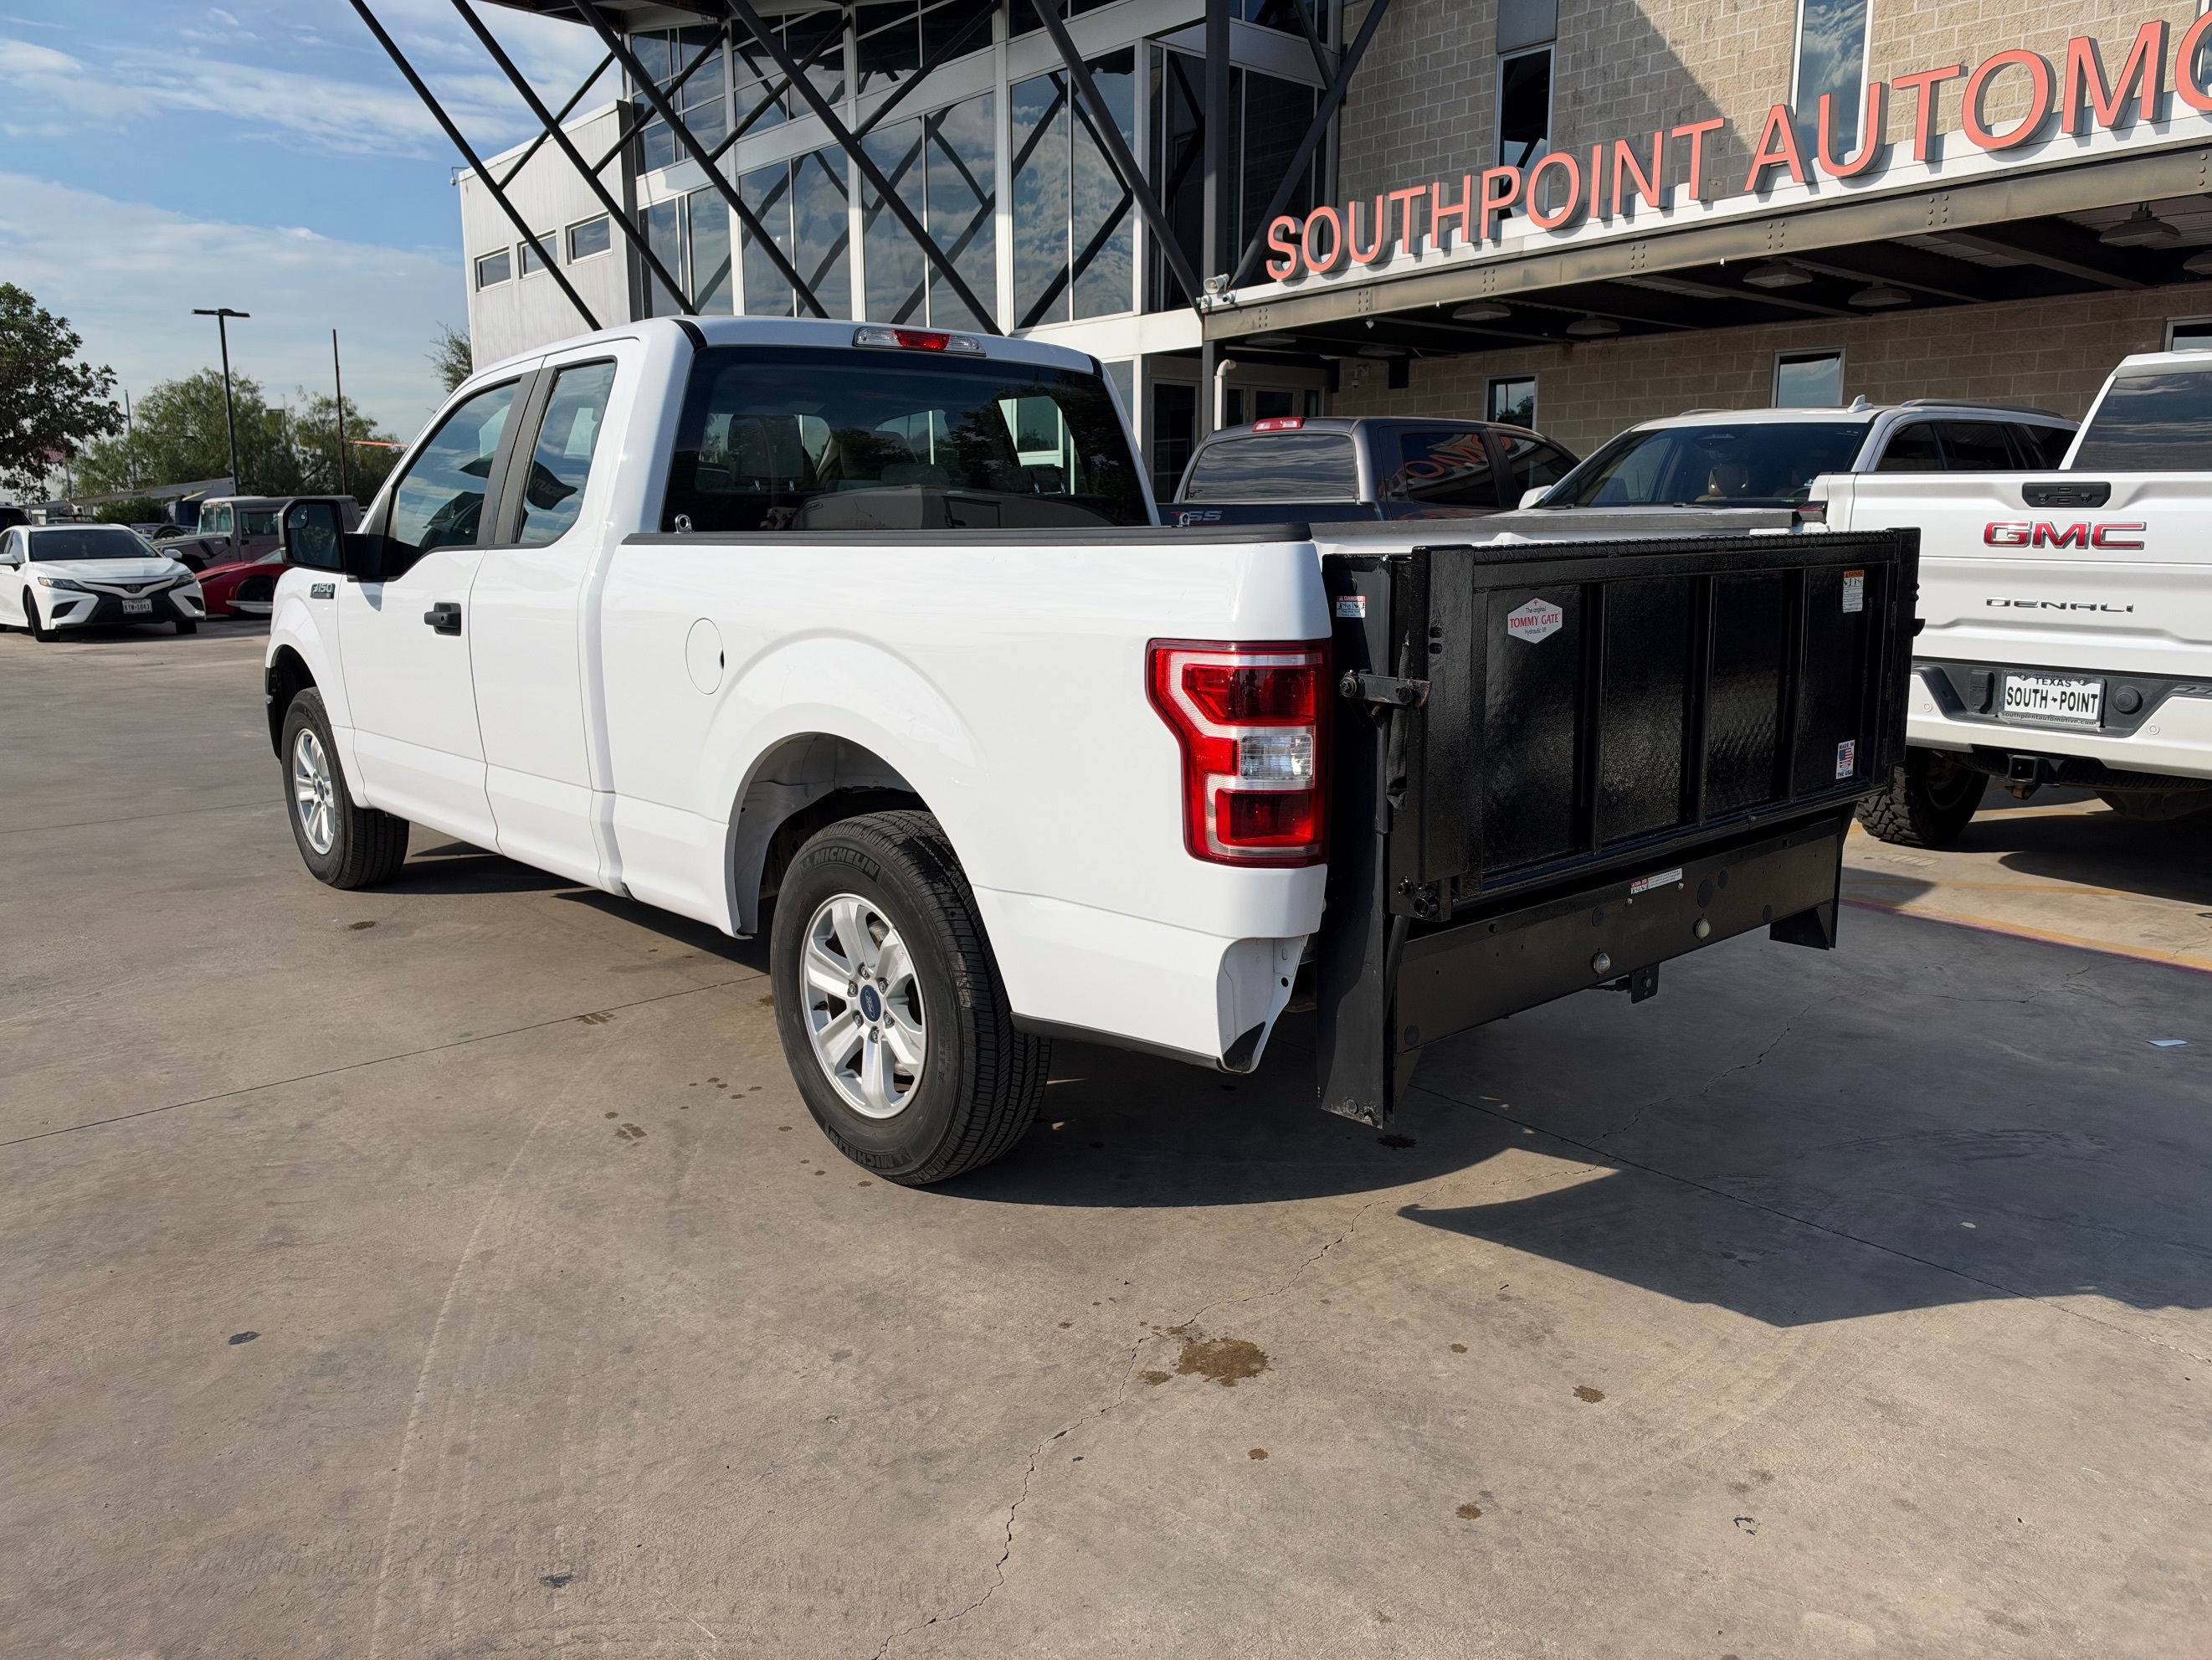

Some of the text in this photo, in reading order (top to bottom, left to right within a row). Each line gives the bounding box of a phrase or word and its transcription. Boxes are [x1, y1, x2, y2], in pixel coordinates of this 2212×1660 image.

[1265, 116, 1727, 280] SOUTHPOINT
[1984, 521, 2147, 550] GMC
[1986, 597, 2134, 613] DENALI
[1510, 613, 1559, 629] TOMMY GATE
[1524, 627, 1542, 636] hydraulic
[2035, 676, 2072, 688] TEXAS
[2006, 686, 2099, 714] SOUTH POINT
[2001, 711, 2097, 725] southpointautomotive.com
[1839, 742, 1850, 750] MADE
[813, 846, 880, 877] MICHELIN
[829, 1130, 895, 1169] MICHELIN
